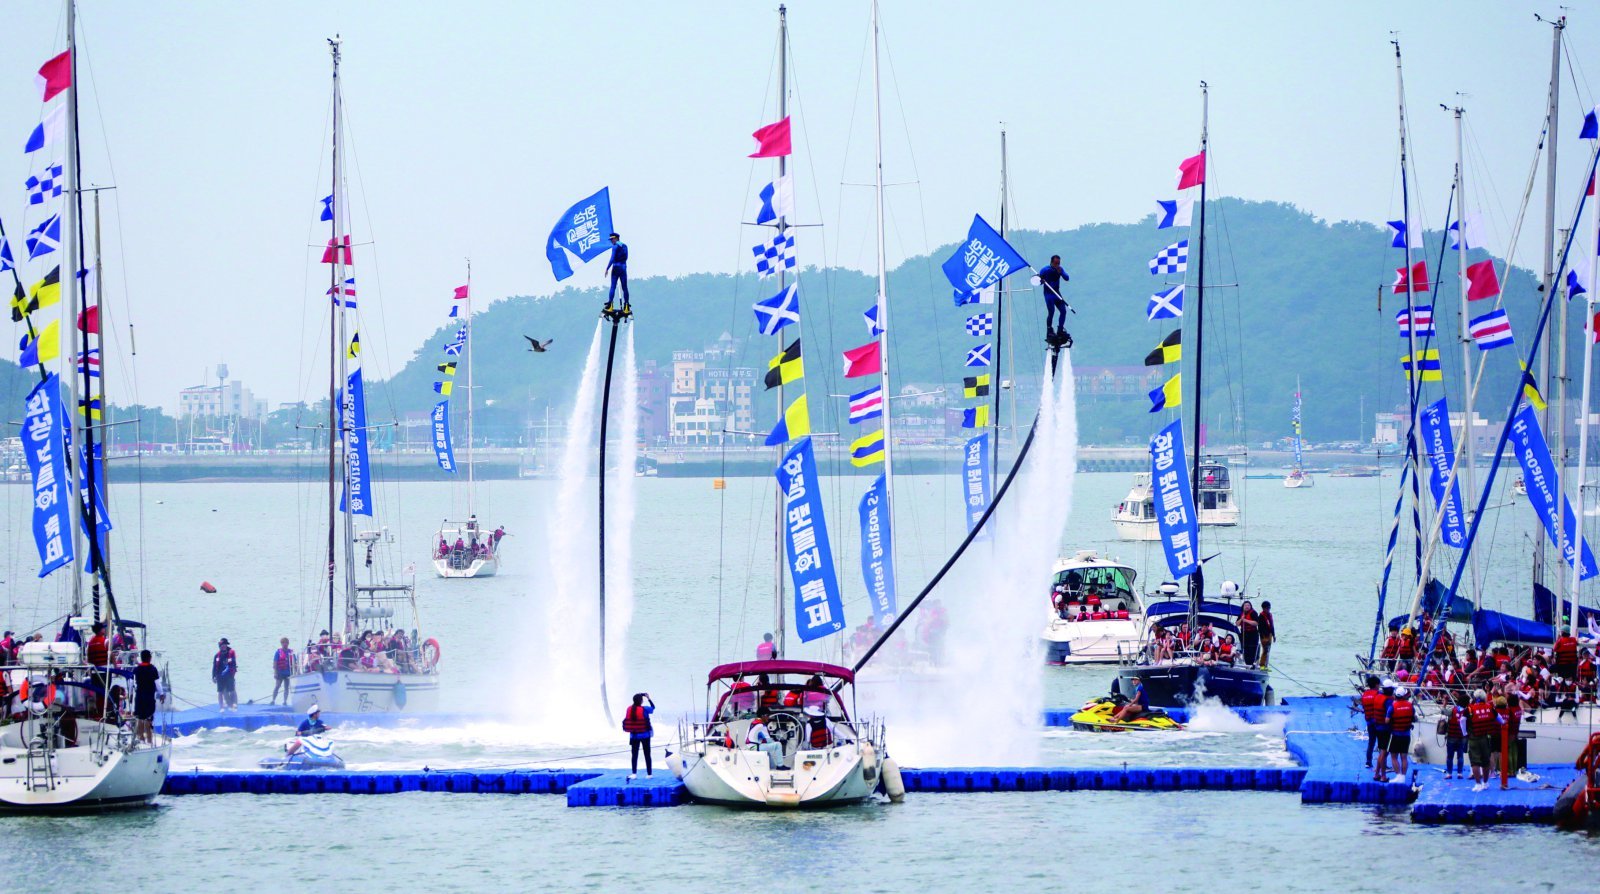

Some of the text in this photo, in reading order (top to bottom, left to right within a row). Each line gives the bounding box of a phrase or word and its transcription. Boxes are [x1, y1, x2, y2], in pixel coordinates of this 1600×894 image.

[26, 389, 53, 441] 화성
[44, 513, 64, 565] 축제
[967, 440, 982, 466] 화성
[967, 468, 985, 506] 뱃놀이
[1153, 431, 1195, 570] 화성 뱃놀이 축제
[783, 452, 833, 629] 화성 뱃놀이 축제
